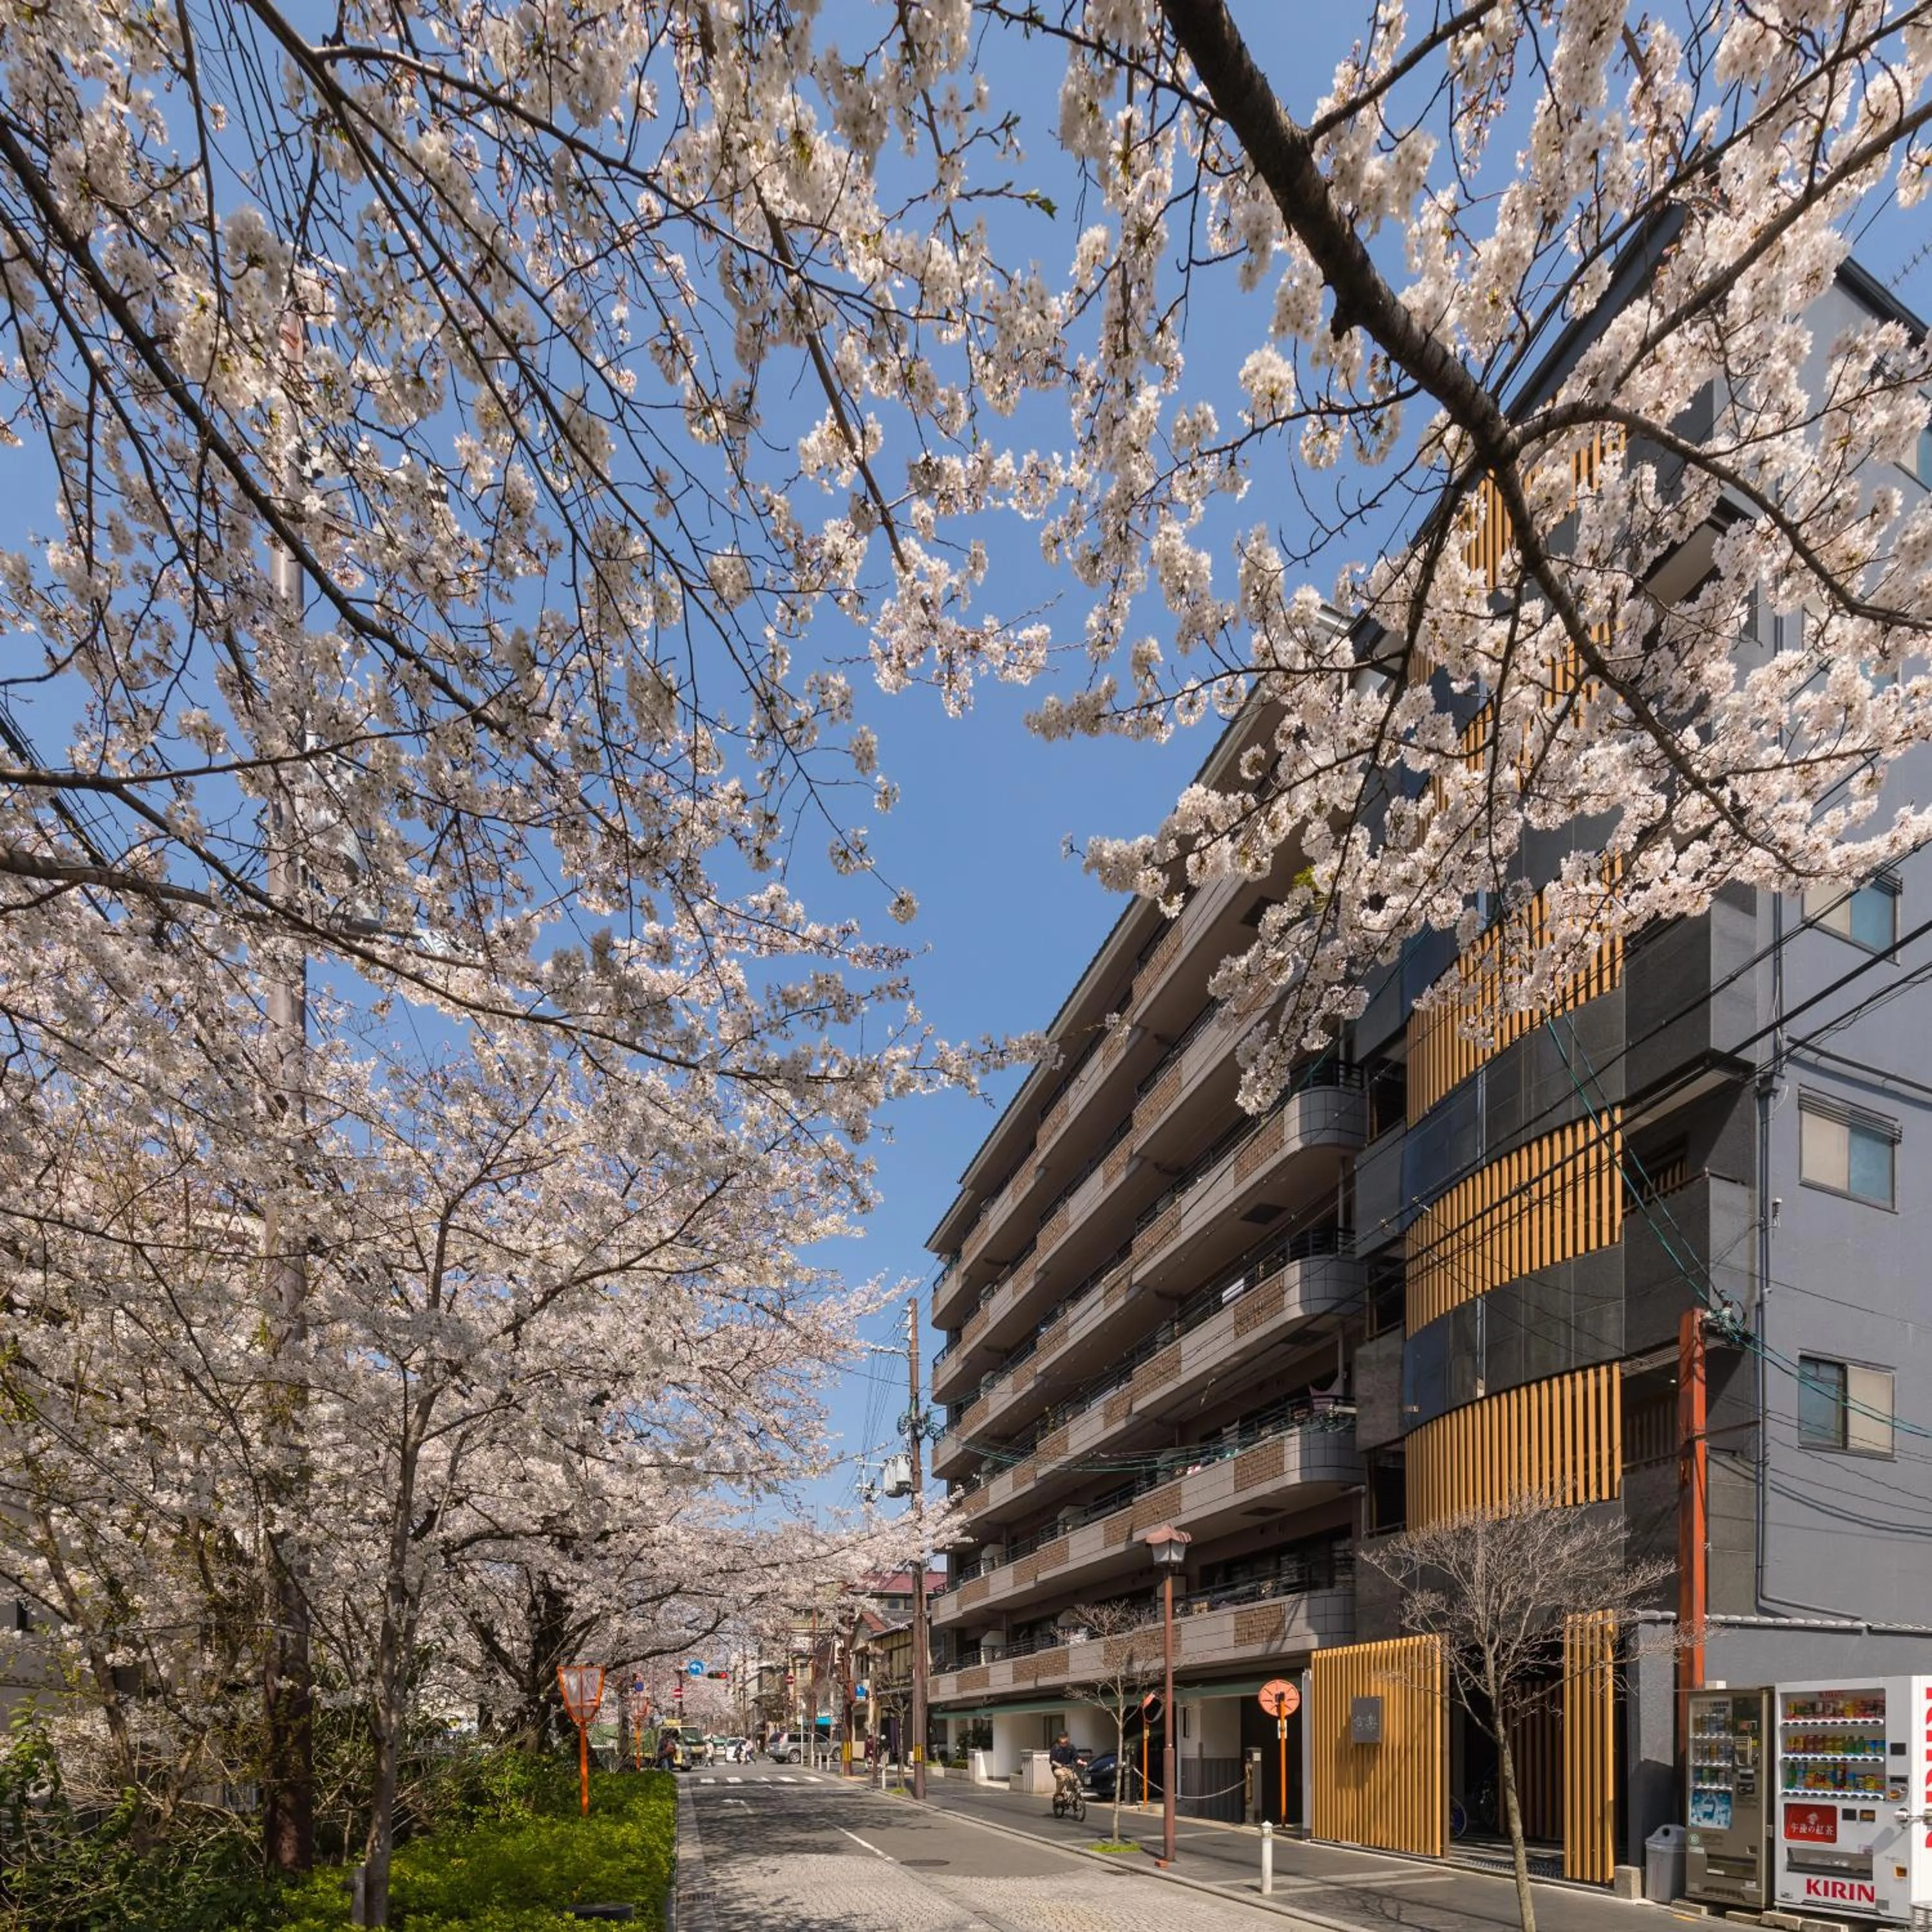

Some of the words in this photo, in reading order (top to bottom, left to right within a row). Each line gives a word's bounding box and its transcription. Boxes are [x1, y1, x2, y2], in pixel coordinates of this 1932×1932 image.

[1791, 1823, 1835, 1836] 午後の紅茶
[1806, 1879, 1875, 1902] KIRIN
